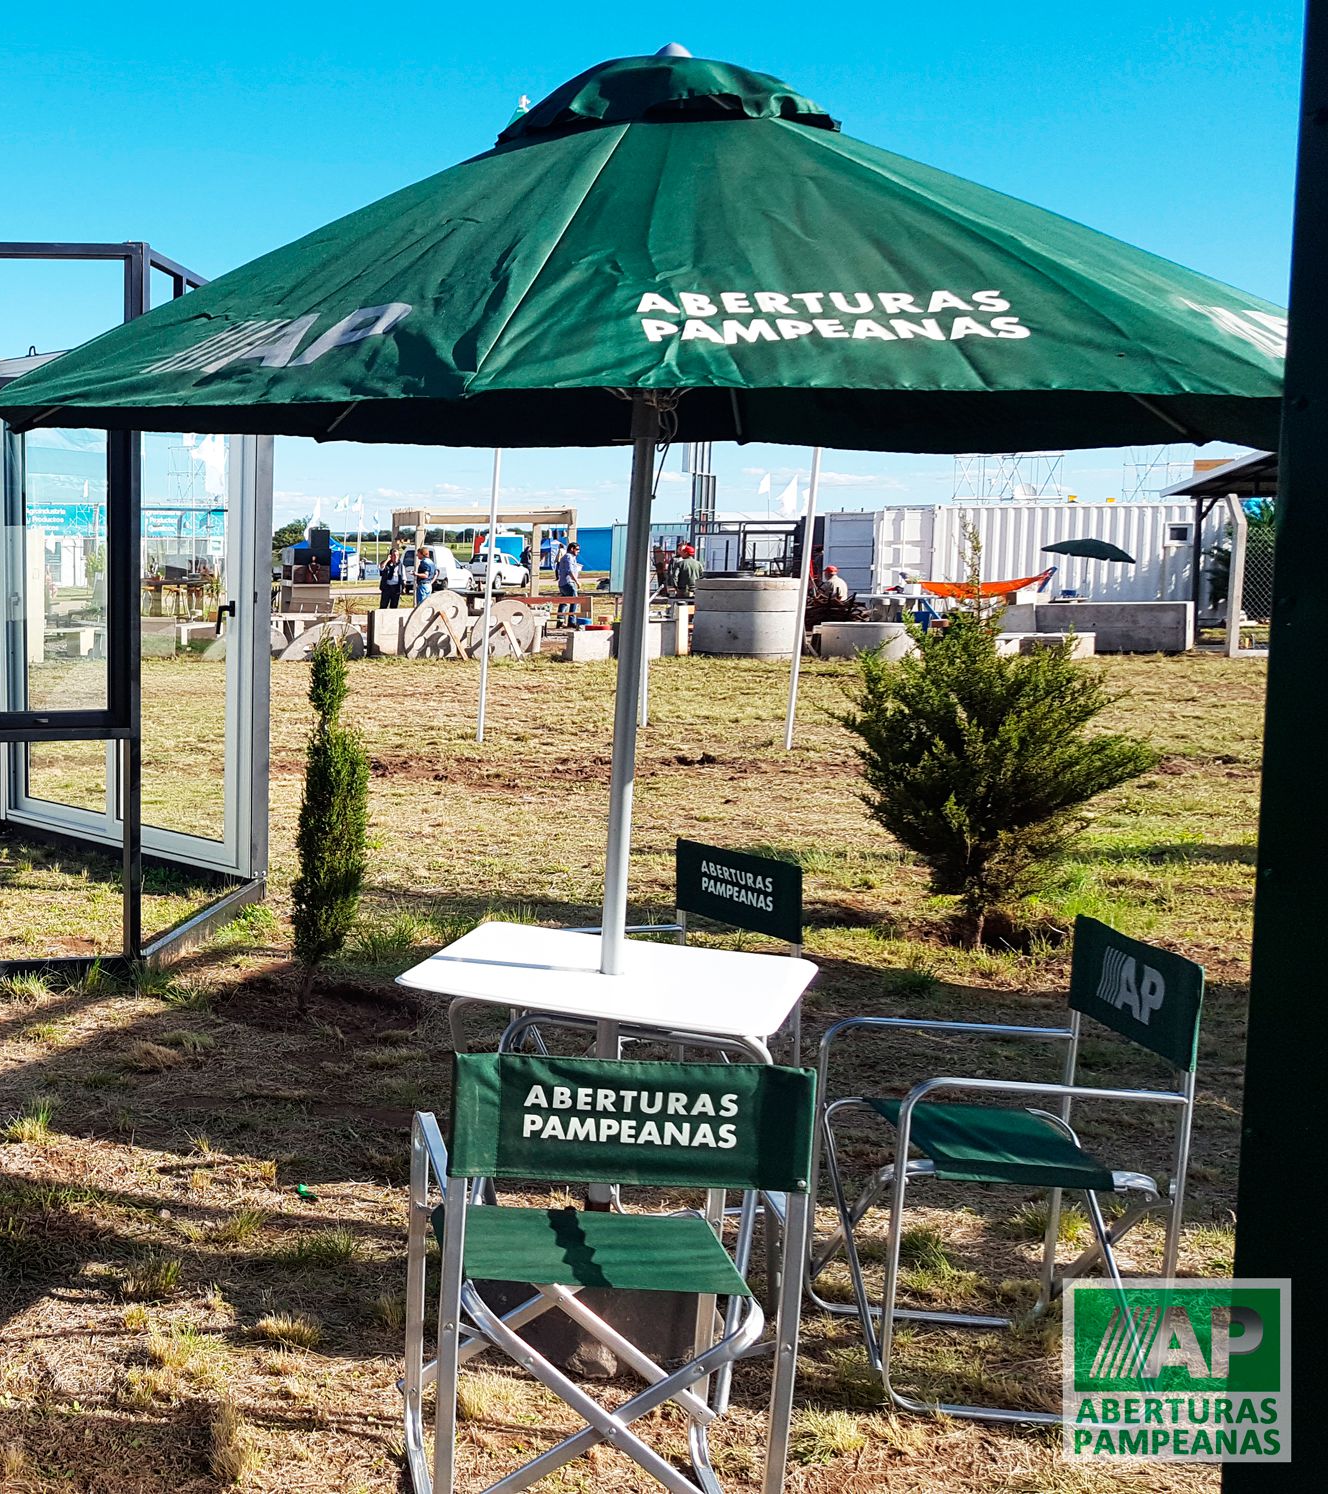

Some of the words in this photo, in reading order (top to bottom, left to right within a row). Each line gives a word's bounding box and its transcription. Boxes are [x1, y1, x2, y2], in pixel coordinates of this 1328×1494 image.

[637, 290, 1011, 317] ABERTURAS
[641, 317, 1031, 345] PAMPEANAS
[701, 860, 773, 893] ABERTURAS
[701, 877, 773, 912] PAMPEANAS
[1113, 956, 1165, 1025] AP
[523, 1084, 739, 1117] ABERTURAS
[523, 1114, 737, 1148] PAMPEANAS
